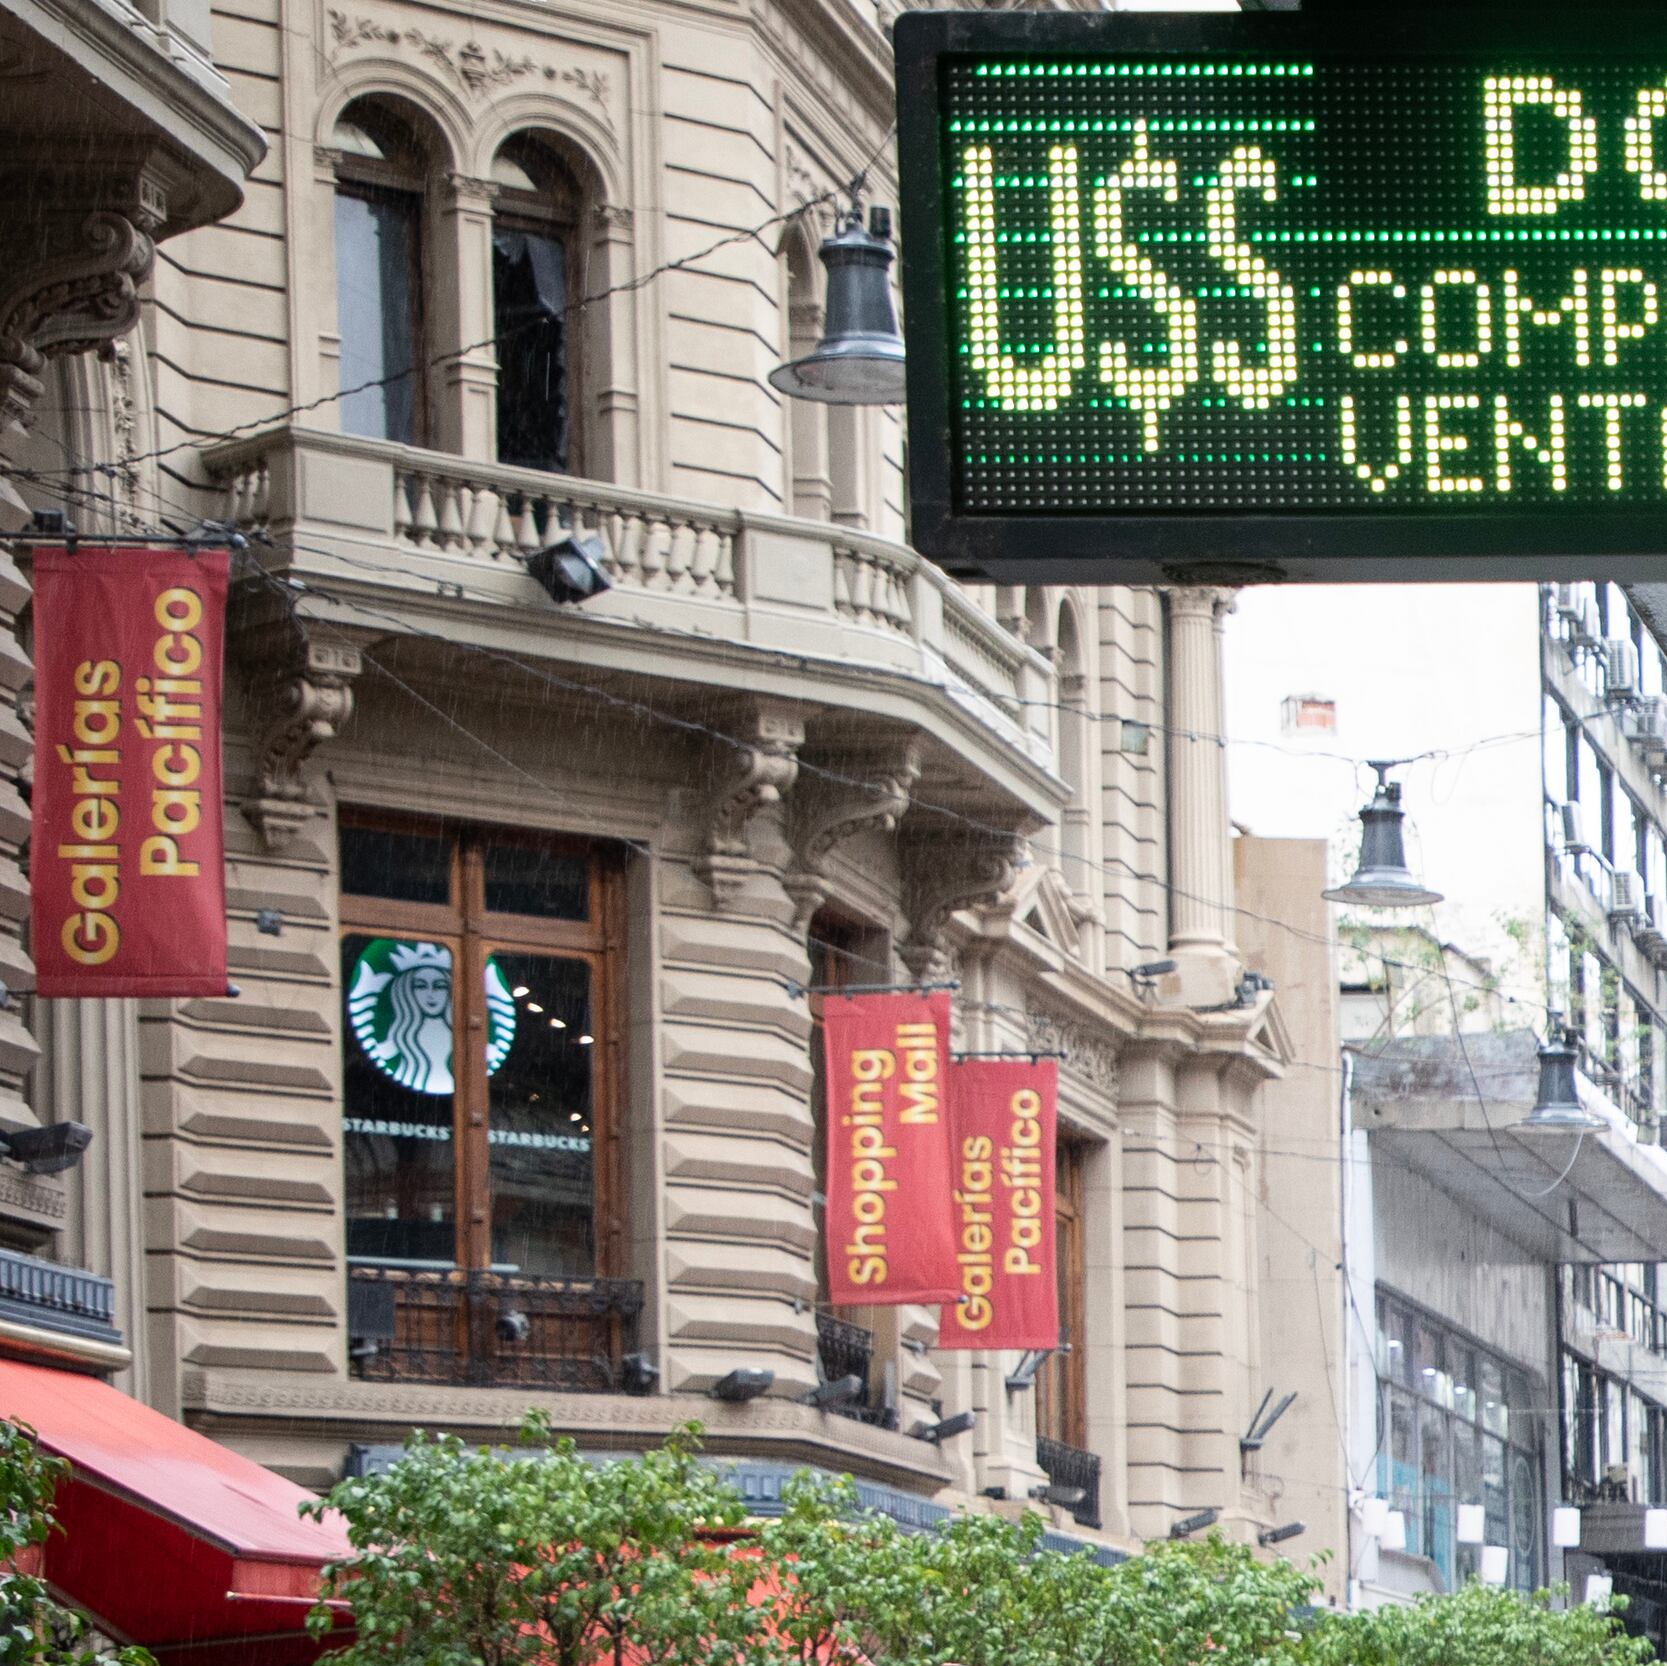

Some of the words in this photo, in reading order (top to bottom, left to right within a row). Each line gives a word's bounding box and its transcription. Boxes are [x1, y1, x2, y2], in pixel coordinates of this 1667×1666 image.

[57, 658, 122, 966] Galerías
[134, 586, 203, 877] Pacífico
[343, 1117, 450, 1141] STARBUCKS
[487, 1129, 590, 1152] STARBUCKS
[842, 1048, 896, 1285] Shopping
[896, 1022, 939, 1124] Mall
[953, 1135, 994, 1331] Galerías
[1000, 1088, 1042, 1275] Pacífico
